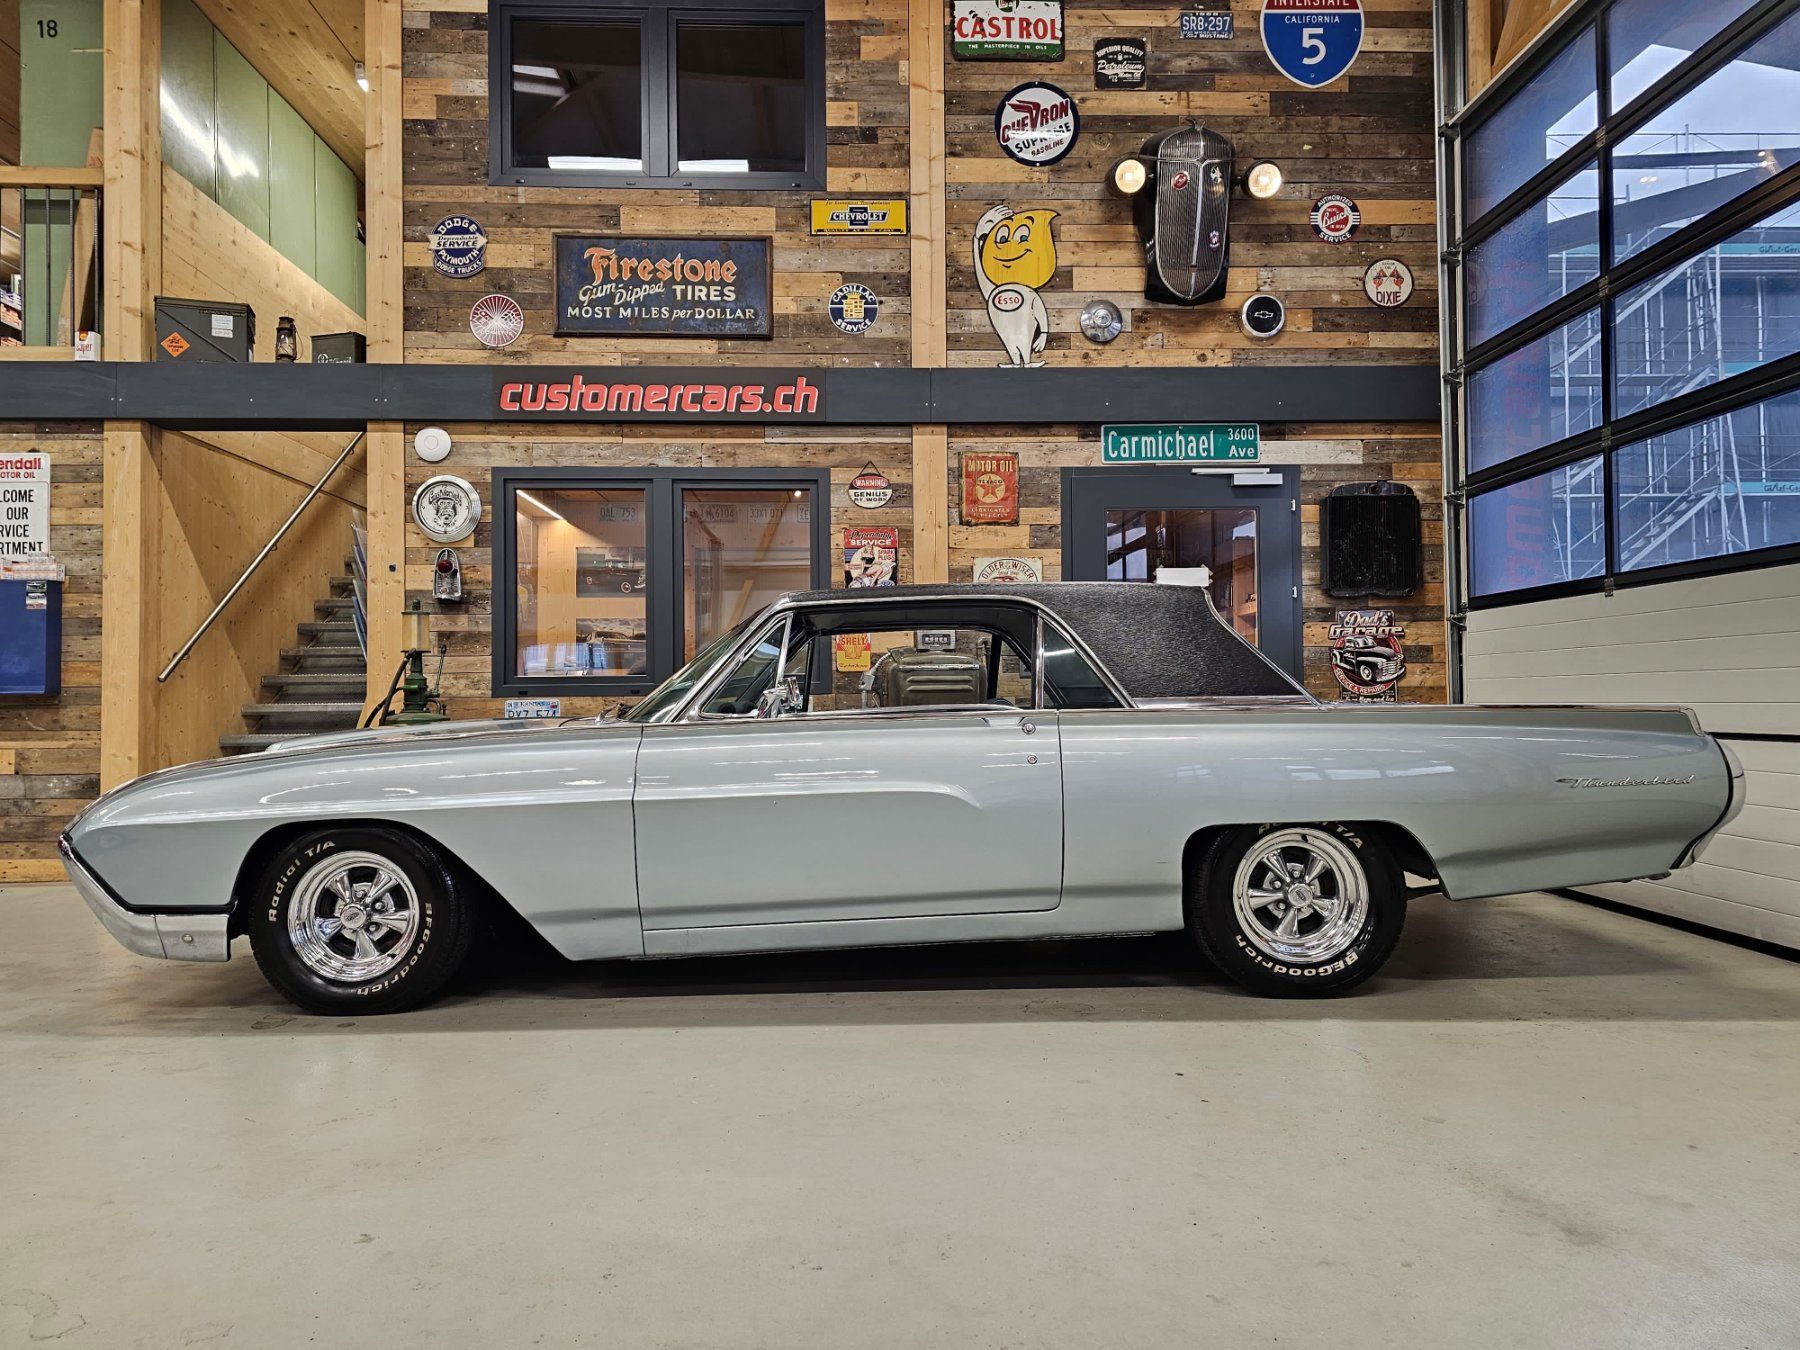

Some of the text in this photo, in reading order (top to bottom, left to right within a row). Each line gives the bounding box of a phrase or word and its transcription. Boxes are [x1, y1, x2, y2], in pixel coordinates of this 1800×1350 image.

[1285, 15, 1340, 23] CALIFORNIA
[36, 19, 58, 38] 18
[956, 16, 1061, 40] CASTROL
[1302, 27, 1326, 65] 5
[1002, 98, 1069, 143] CHEVRON
[1031, 139, 1064, 157] GASOLINE
[1318, 194, 1353, 207] AUTHORIZED
[833, 212, 883, 221] CHEVROLET
[1322, 206, 1351, 228] Buick
[437, 218, 478, 234] DODGE
[436, 240, 477, 248] SERVICE
[1319, 232, 1351, 243] SERVICE
[438, 249, 480, 265] PLYMOUTH
[436, 261, 482, 274] DODGE TRUCKS
[584, 246, 737, 287] Firestone
[672, 285, 736, 301] TIRES
[833, 285, 875, 303] CADILLAC
[1376, 291, 1402, 305] DIXIE
[567, 306, 755, 321] MOST MILES per DOLLAR
[836, 318, 872, 332] SERVICE
[500, 375, 818, 414] customercars.ch
[1108, 428, 1254, 457] Carmichael 3600
[1229, 445, 1255, 457] Ave
[1000, 460, 1013, 472] OIL
[23, 471, 36, 479] OIL
[856, 479, 886, 487] WARNING
[0, 489, 34, 503] COME
[6, 507, 29, 520] OUR
[982, 561, 1034, 579] OLDER WISER
[1344, 611, 1389, 627] Dad's
[1329, 625, 1404, 639] Garage
[841, 637, 866, 646] SHELL
[1555, 774, 1696, 788] Thunderbird
[1336, 824, 1363, 849] T/A
[268, 840, 336, 922] Radial T/A
[356, 902, 433, 996] BFGoodrich
[1235, 934, 1359, 977] BFGoodrich
